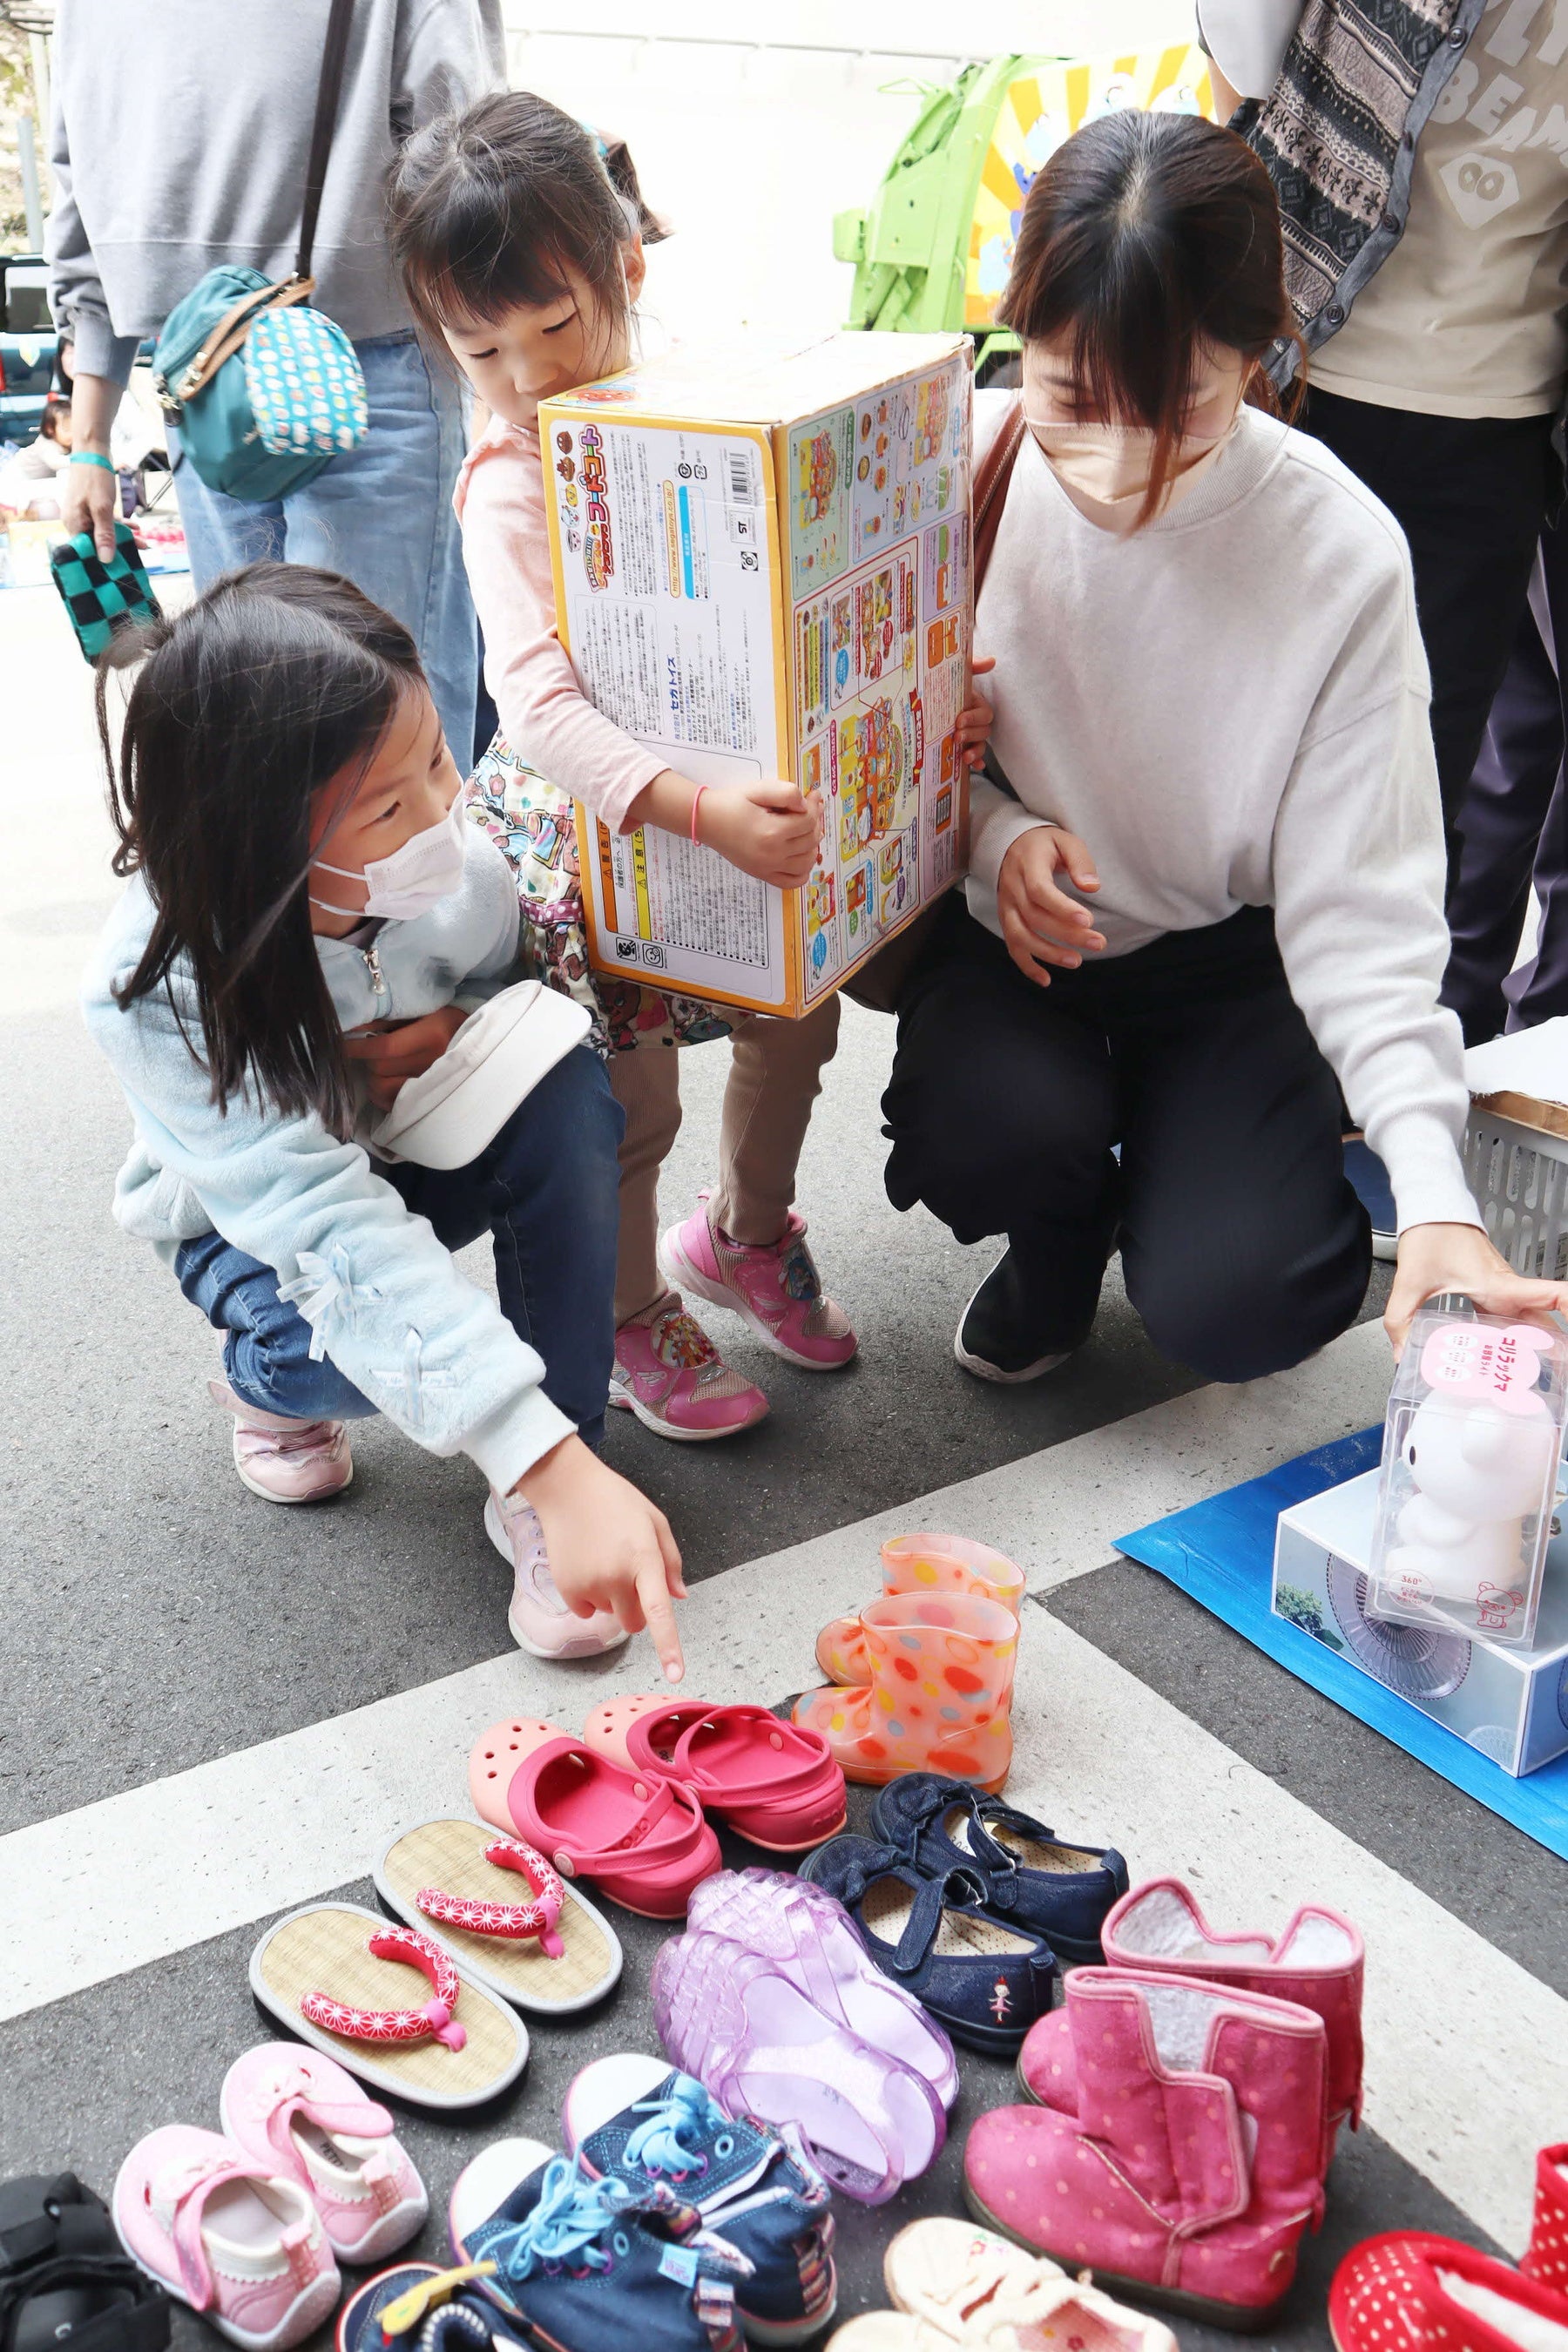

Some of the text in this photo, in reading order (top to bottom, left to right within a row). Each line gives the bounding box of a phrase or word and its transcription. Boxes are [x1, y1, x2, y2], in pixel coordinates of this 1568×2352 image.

[581, 428, 607, 522] フードコート
[1494, 1337, 1517, 1392] コリラックマ
